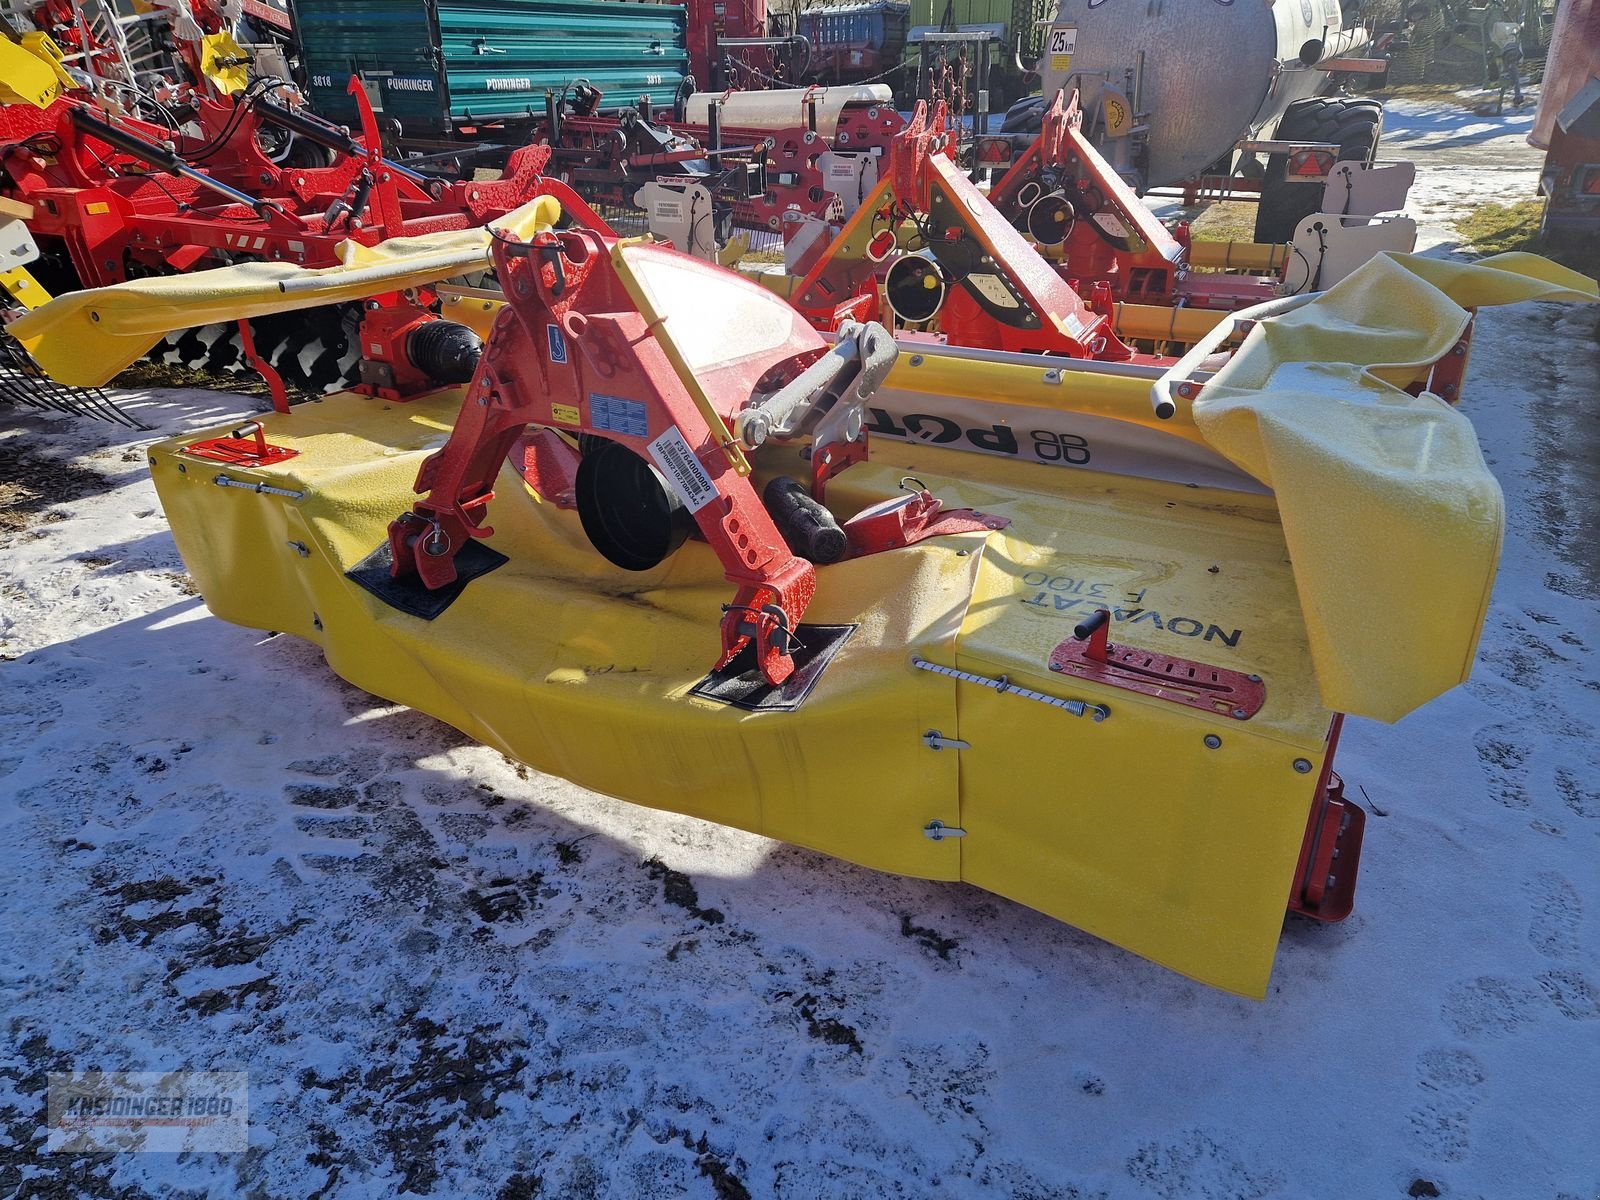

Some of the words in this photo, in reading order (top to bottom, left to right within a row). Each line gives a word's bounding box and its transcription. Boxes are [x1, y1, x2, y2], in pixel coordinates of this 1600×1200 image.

[1052, 31, 1066, 52] 25
[1064, 41, 1074, 52] km
[312, 75, 332, 87] 3818
[1021, 571, 1114, 599] 3100
